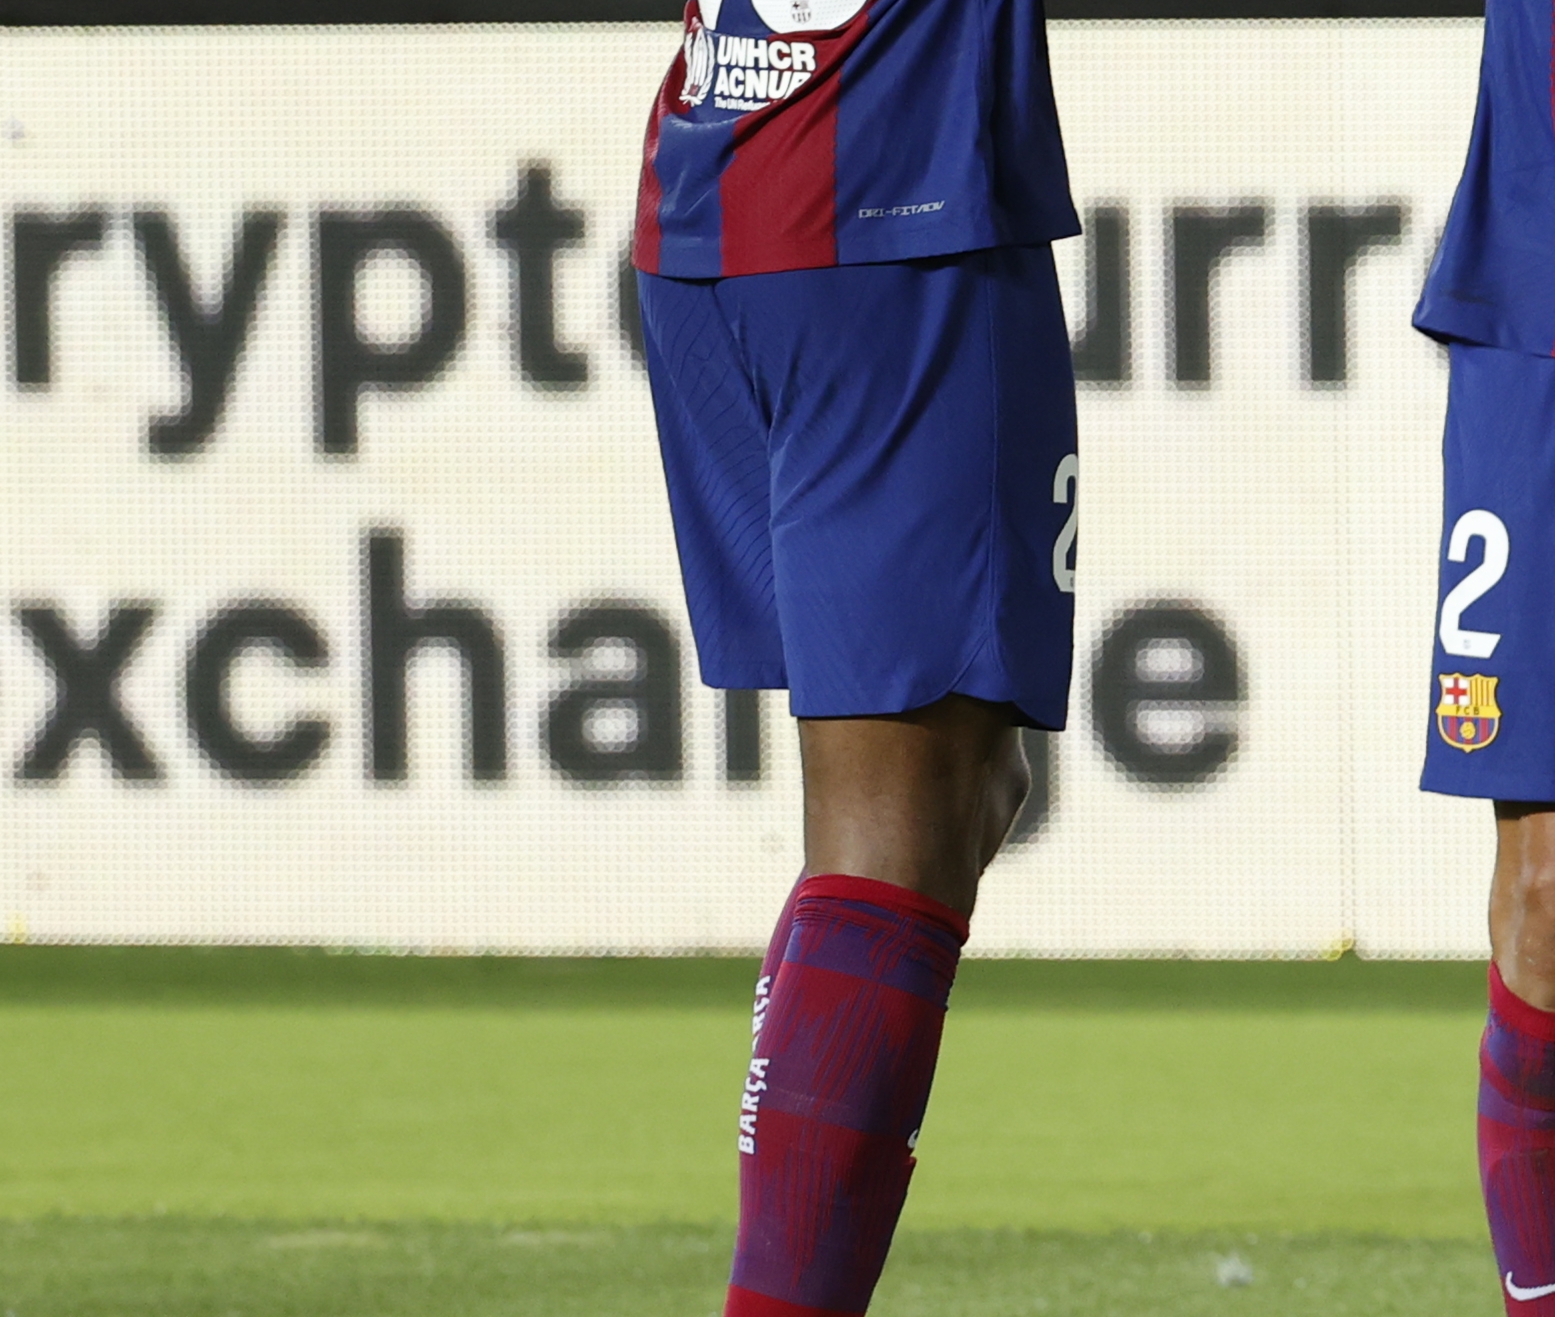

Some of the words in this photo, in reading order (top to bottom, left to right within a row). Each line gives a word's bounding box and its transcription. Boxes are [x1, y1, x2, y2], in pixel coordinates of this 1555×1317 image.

[716, 35, 816, 72] UNHCR
[1439, 509, 1510, 659] 2
[738, 1058, 770, 1155] BARÇA
